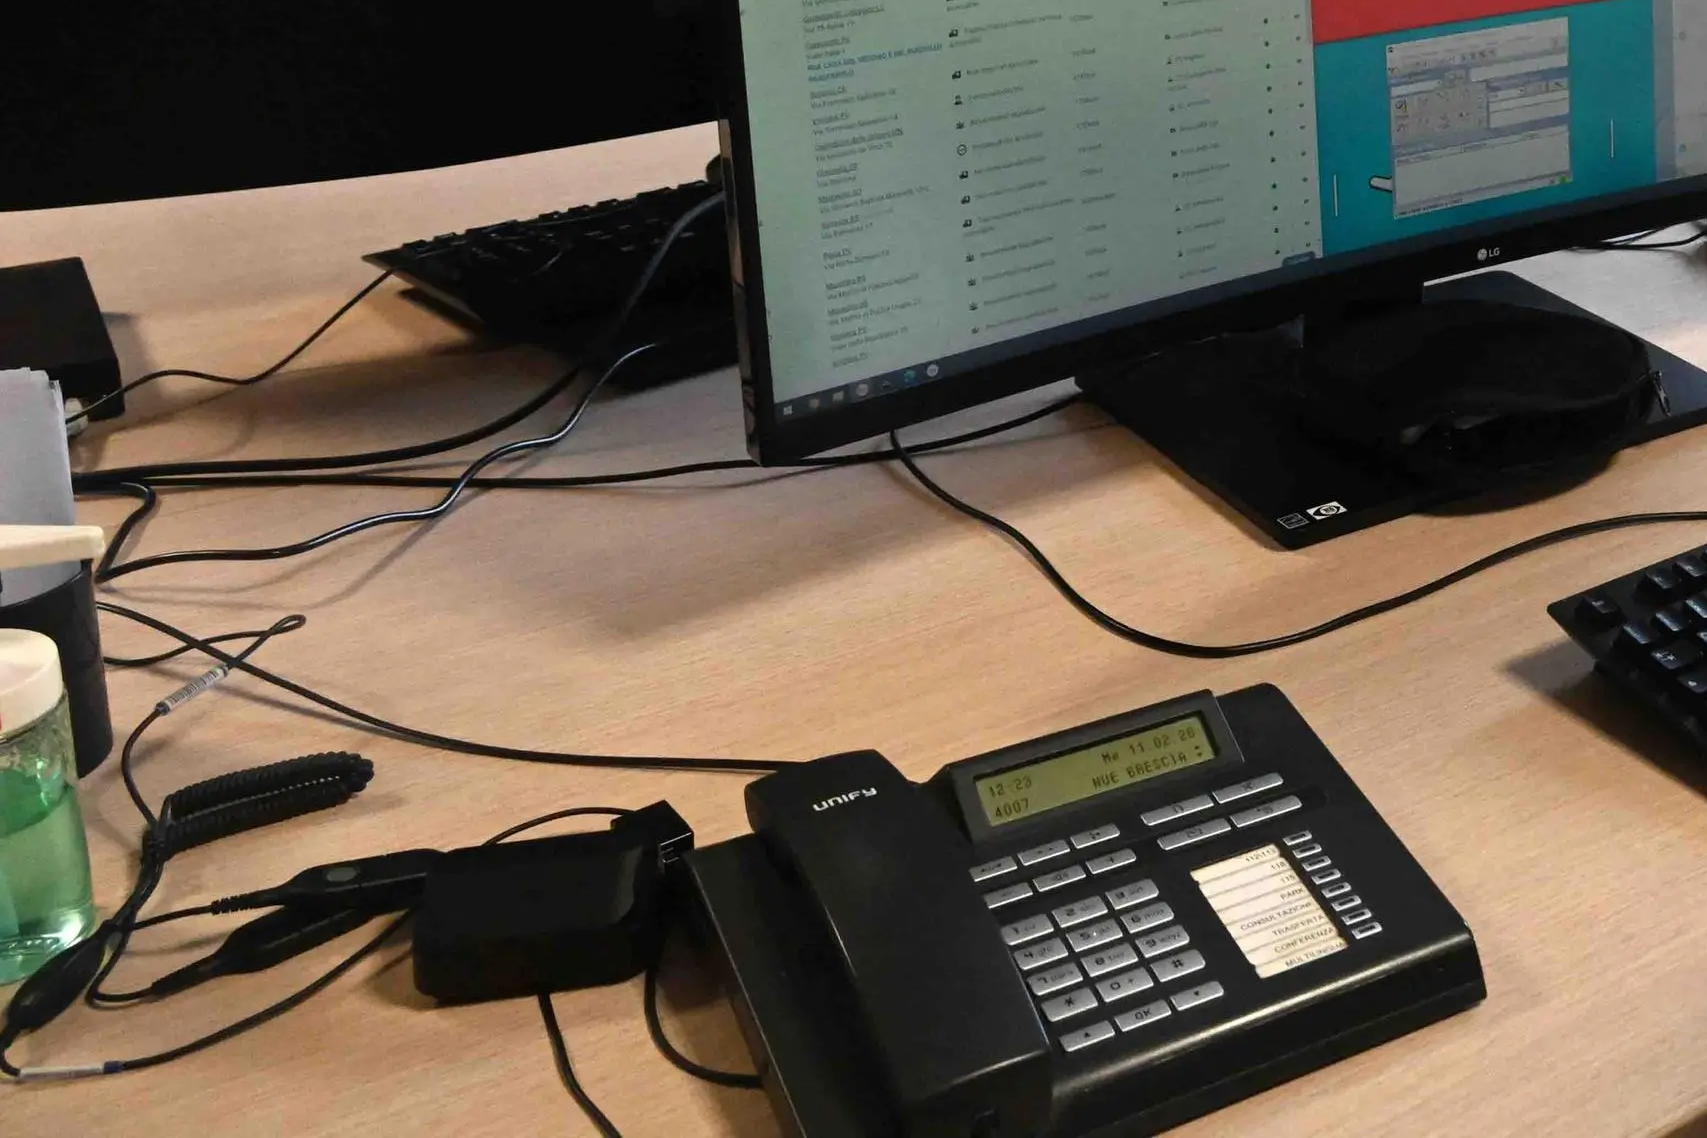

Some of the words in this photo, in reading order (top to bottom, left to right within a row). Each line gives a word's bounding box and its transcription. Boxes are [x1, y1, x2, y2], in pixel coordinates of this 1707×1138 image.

[1488, 247, 1500, 258] LG
[994, 797, 1029, 818] 4007
[1125, 751, 1188, 779] BRESCIA
[1274, 926, 1335, 953] CONFERENZA
[1134, 1008, 1152, 1020] OK
